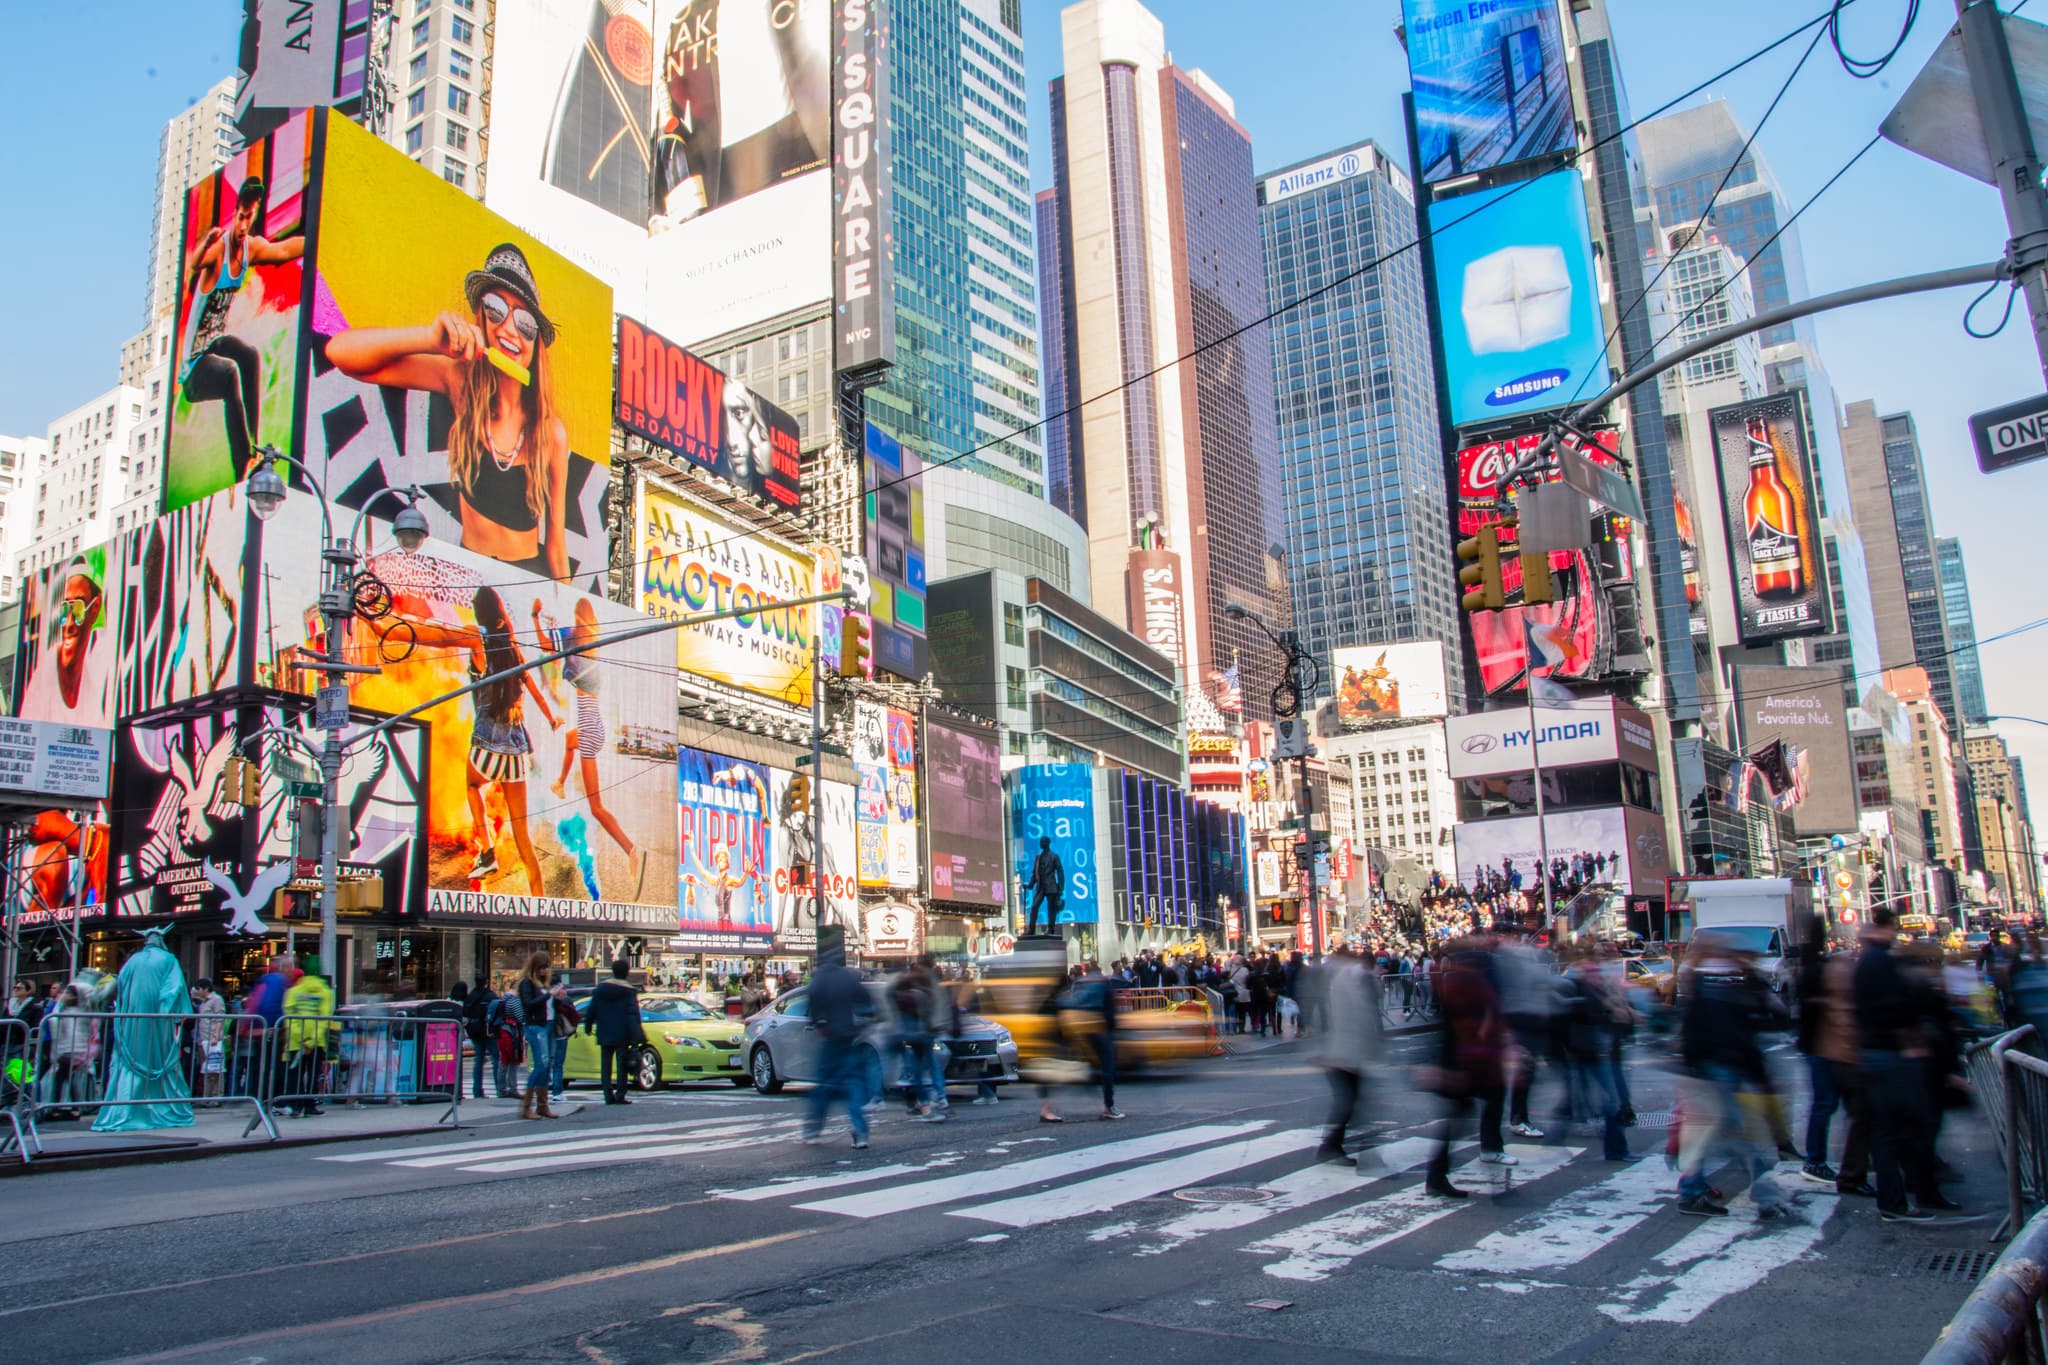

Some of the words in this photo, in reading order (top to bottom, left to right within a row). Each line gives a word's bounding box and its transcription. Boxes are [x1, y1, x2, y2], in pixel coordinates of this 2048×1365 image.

[838, 52, 877, 302] SQUARE
[1278, 165, 1335, 195] Allianz
[725, 235, 785, 266] CHANDON
[846, 326, 872, 345] NYC
[620, 317, 725, 449] ROCKY
[1494, 375, 1561, 399] SAMSUNG
[620, 405, 719, 466] BROADWAY
[769, 425, 799, 459] LOVE
[771, 451, 799, 480] WINS
[643, 545, 808, 650] MOTOWN
[750, 638, 808, 670] MUSICAL
[1765, 694, 1822, 709] America's
[1756, 711, 1806, 725] Favorite
[1807, 711, 1833, 725] Nut.
[1503, 721, 1601, 748] HYUNDAI
[296, 783, 304, 797] 7
[680, 804, 766, 874] PIPPIN
[156, 865, 202, 885] AMERICAN
[171, 880, 215, 896] OUTFITTERS
[431, 891, 531, 917] AMERICAN
[536, 898, 588, 920] EAGLE
[591, 902, 679, 924] OUTFITTERS
